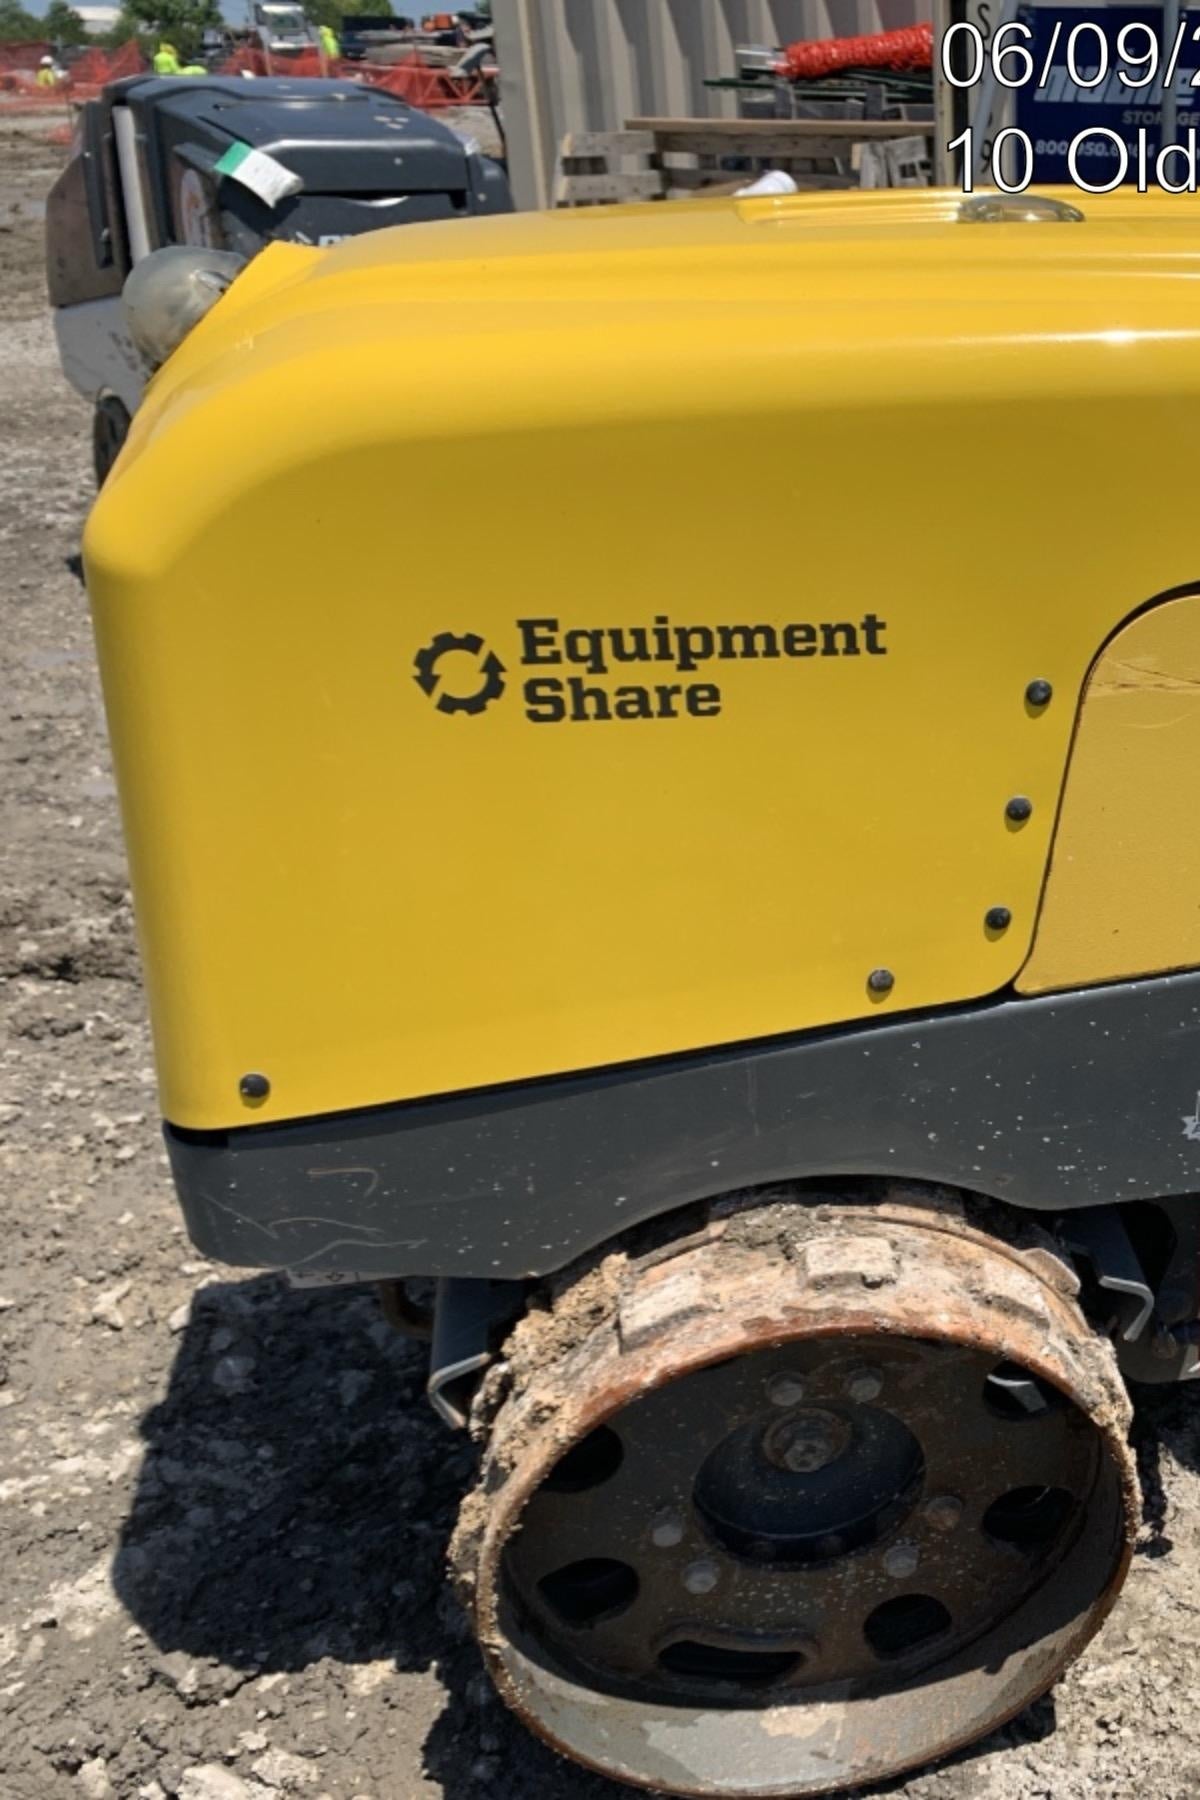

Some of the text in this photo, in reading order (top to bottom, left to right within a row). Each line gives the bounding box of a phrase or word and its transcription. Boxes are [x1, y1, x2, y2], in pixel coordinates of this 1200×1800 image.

[1121, 110, 1200, 126] STORGE
[516, 614, 888, 675] Equipment
[523, 677, 722, 724] Share
